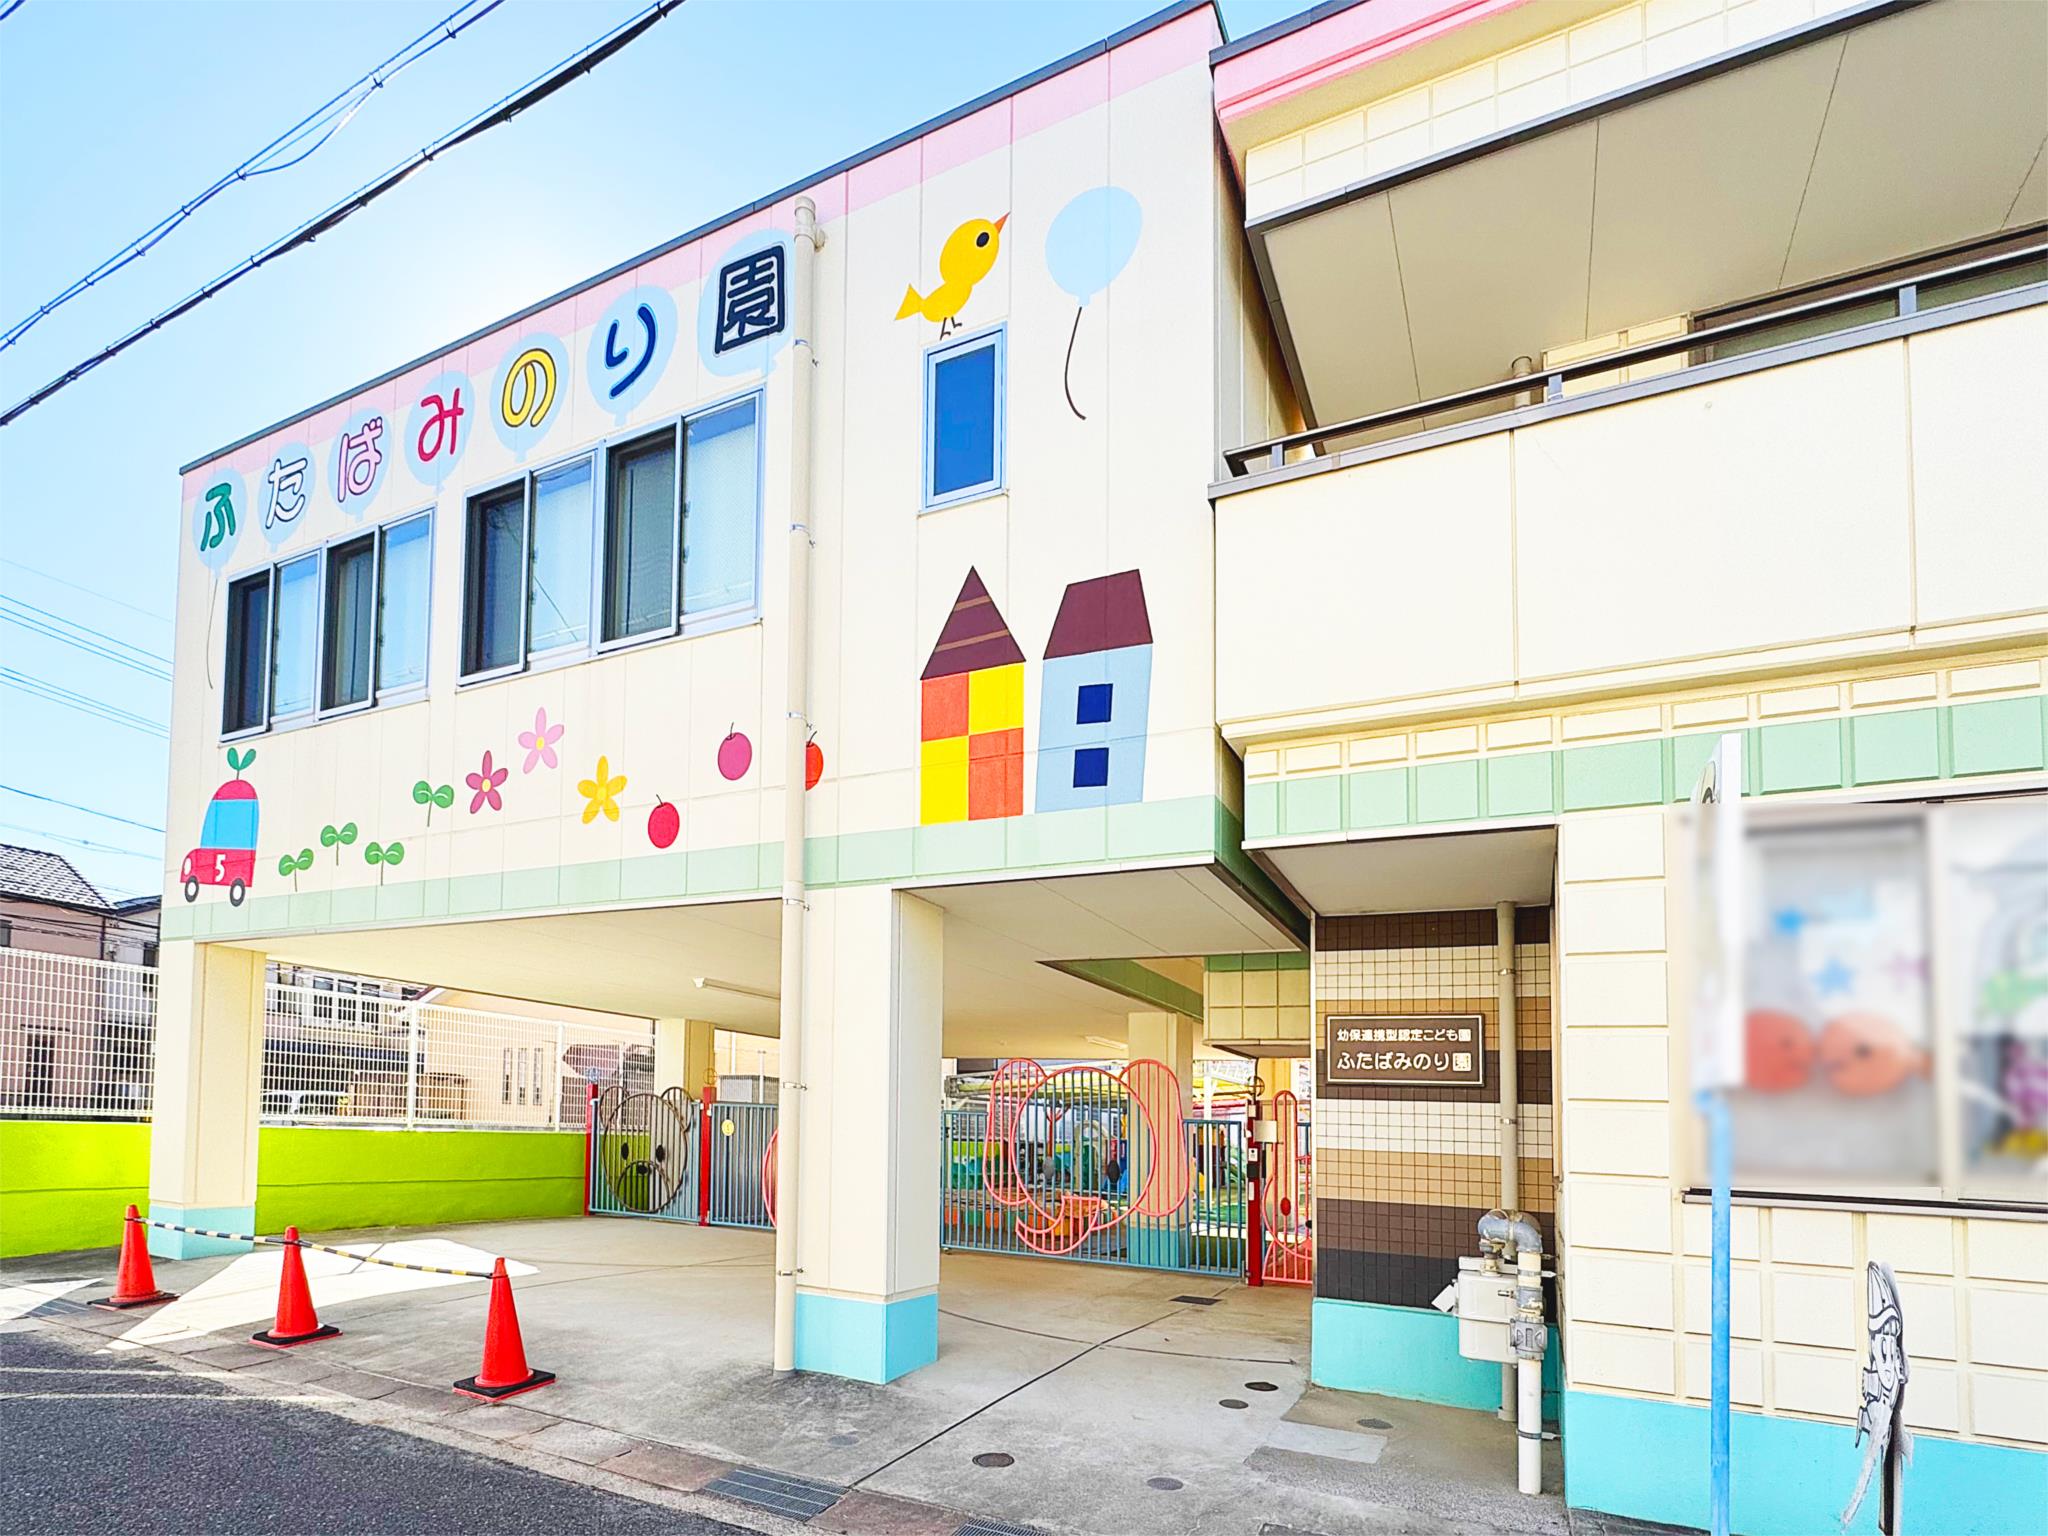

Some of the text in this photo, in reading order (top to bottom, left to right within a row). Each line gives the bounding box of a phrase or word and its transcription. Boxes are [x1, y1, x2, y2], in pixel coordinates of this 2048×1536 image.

[199, 243, 786, 552] ふたばみのり園
[215, 853, 227, 883] 5
[1336, 1028, 1472, 1042] 幼保連携型認定こども園
[1336, 1051, 1473, 1072] ふたばみのり園
